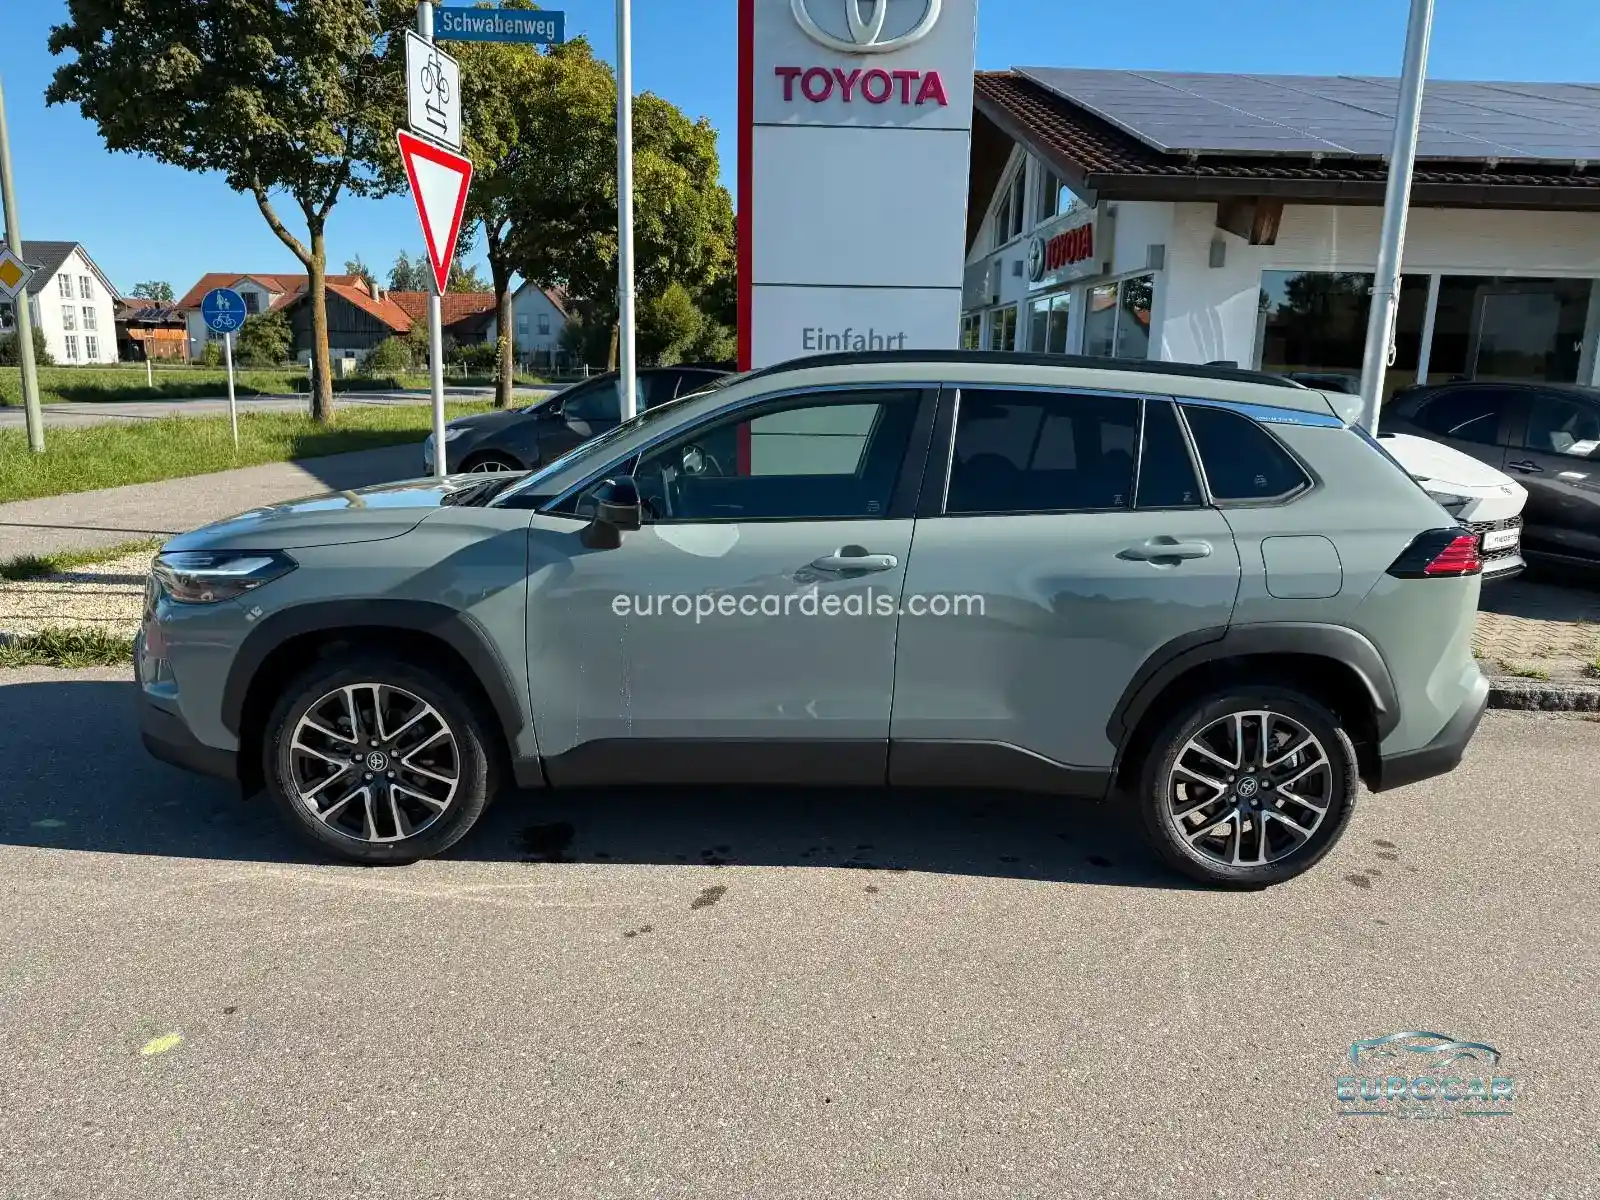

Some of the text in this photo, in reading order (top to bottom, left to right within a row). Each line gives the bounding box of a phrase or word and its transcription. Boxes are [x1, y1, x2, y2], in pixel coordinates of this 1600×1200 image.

[443, 11, 555, 40] Schwabenweg
[774, 66, 948, 106] TOYOTA
[1046, 222, 1093, 271] TOYOTA
[802, 327, 908, 351] Einfahrt
